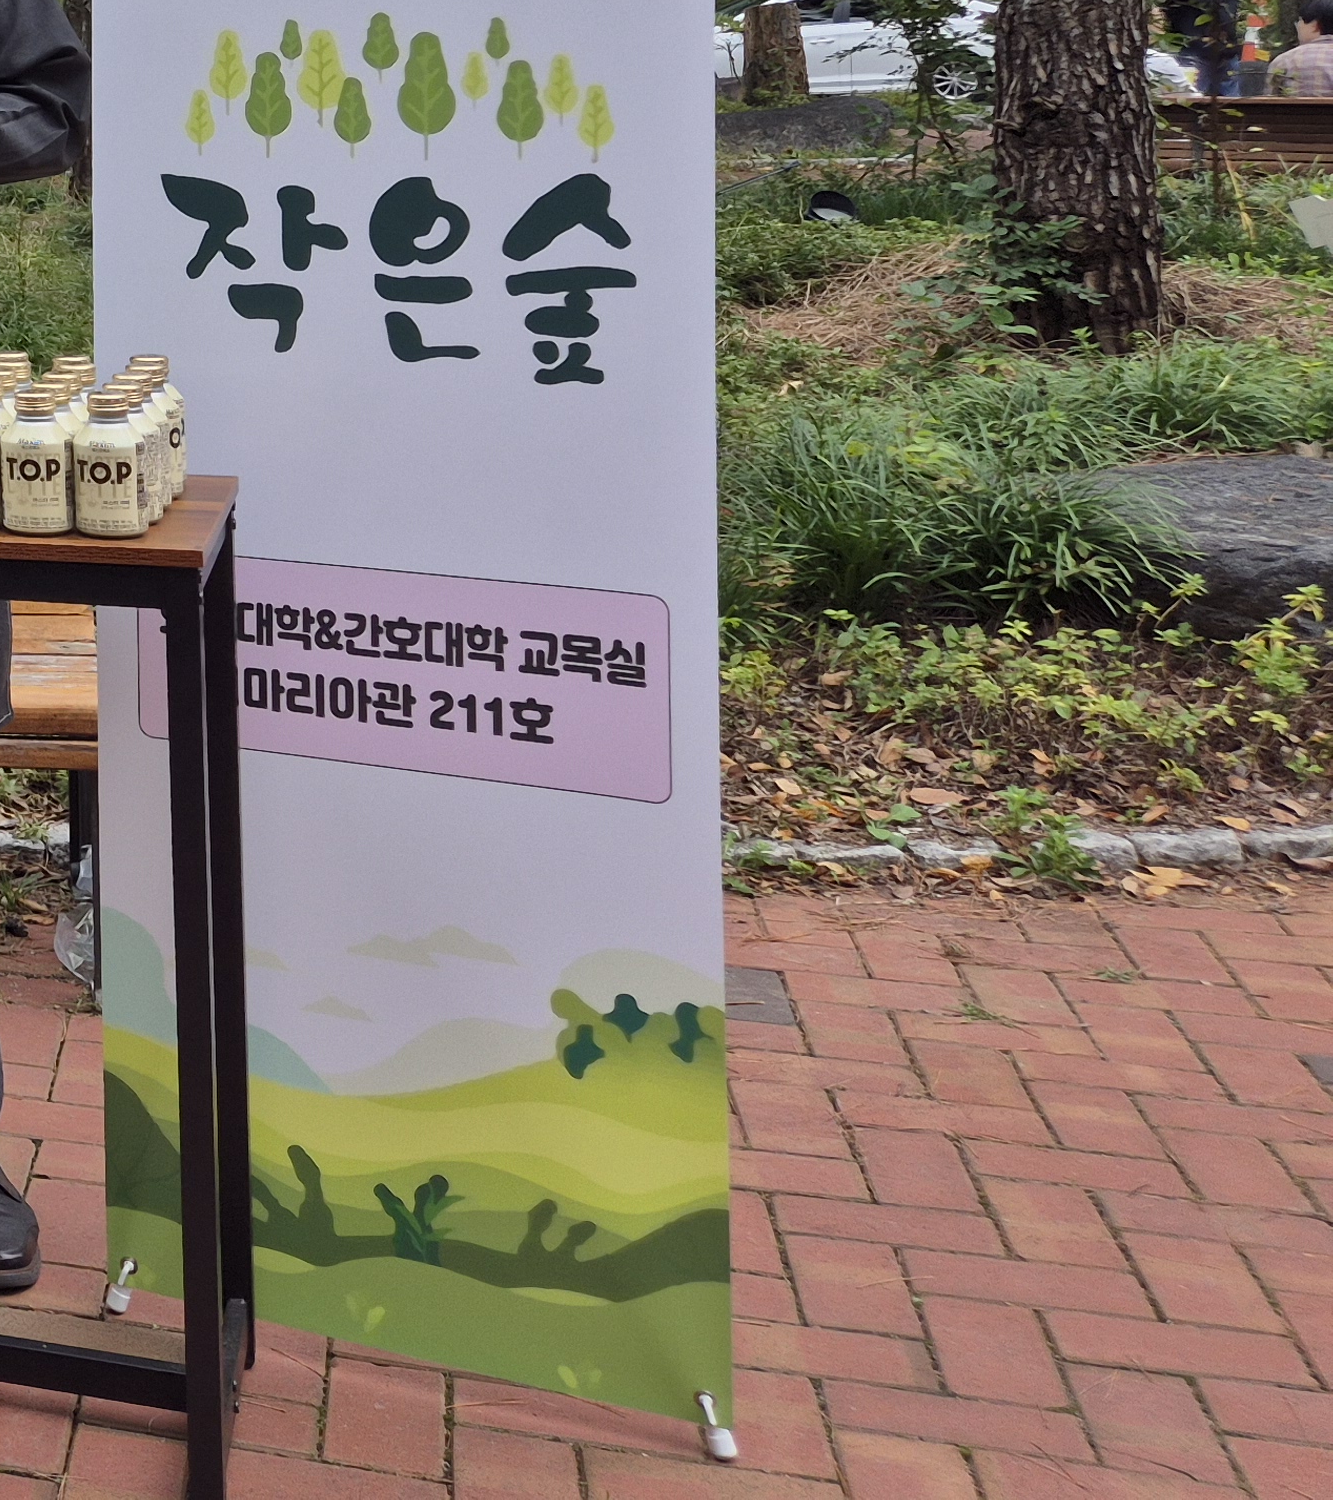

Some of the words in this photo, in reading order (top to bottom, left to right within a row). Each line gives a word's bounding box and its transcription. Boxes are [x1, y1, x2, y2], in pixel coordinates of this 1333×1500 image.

[161, 172, 637, 386] 작은숲
[6, 457, 61, 482] T.O.P
[77, 459, 133, 485] T.O.P
[160, 602, 509, 673] 대학&간호대학
[519, 629, 648, 689] 교목실
[243, 666, 418, 730] 마리아관
[429, 690, 555, 746] 211호
